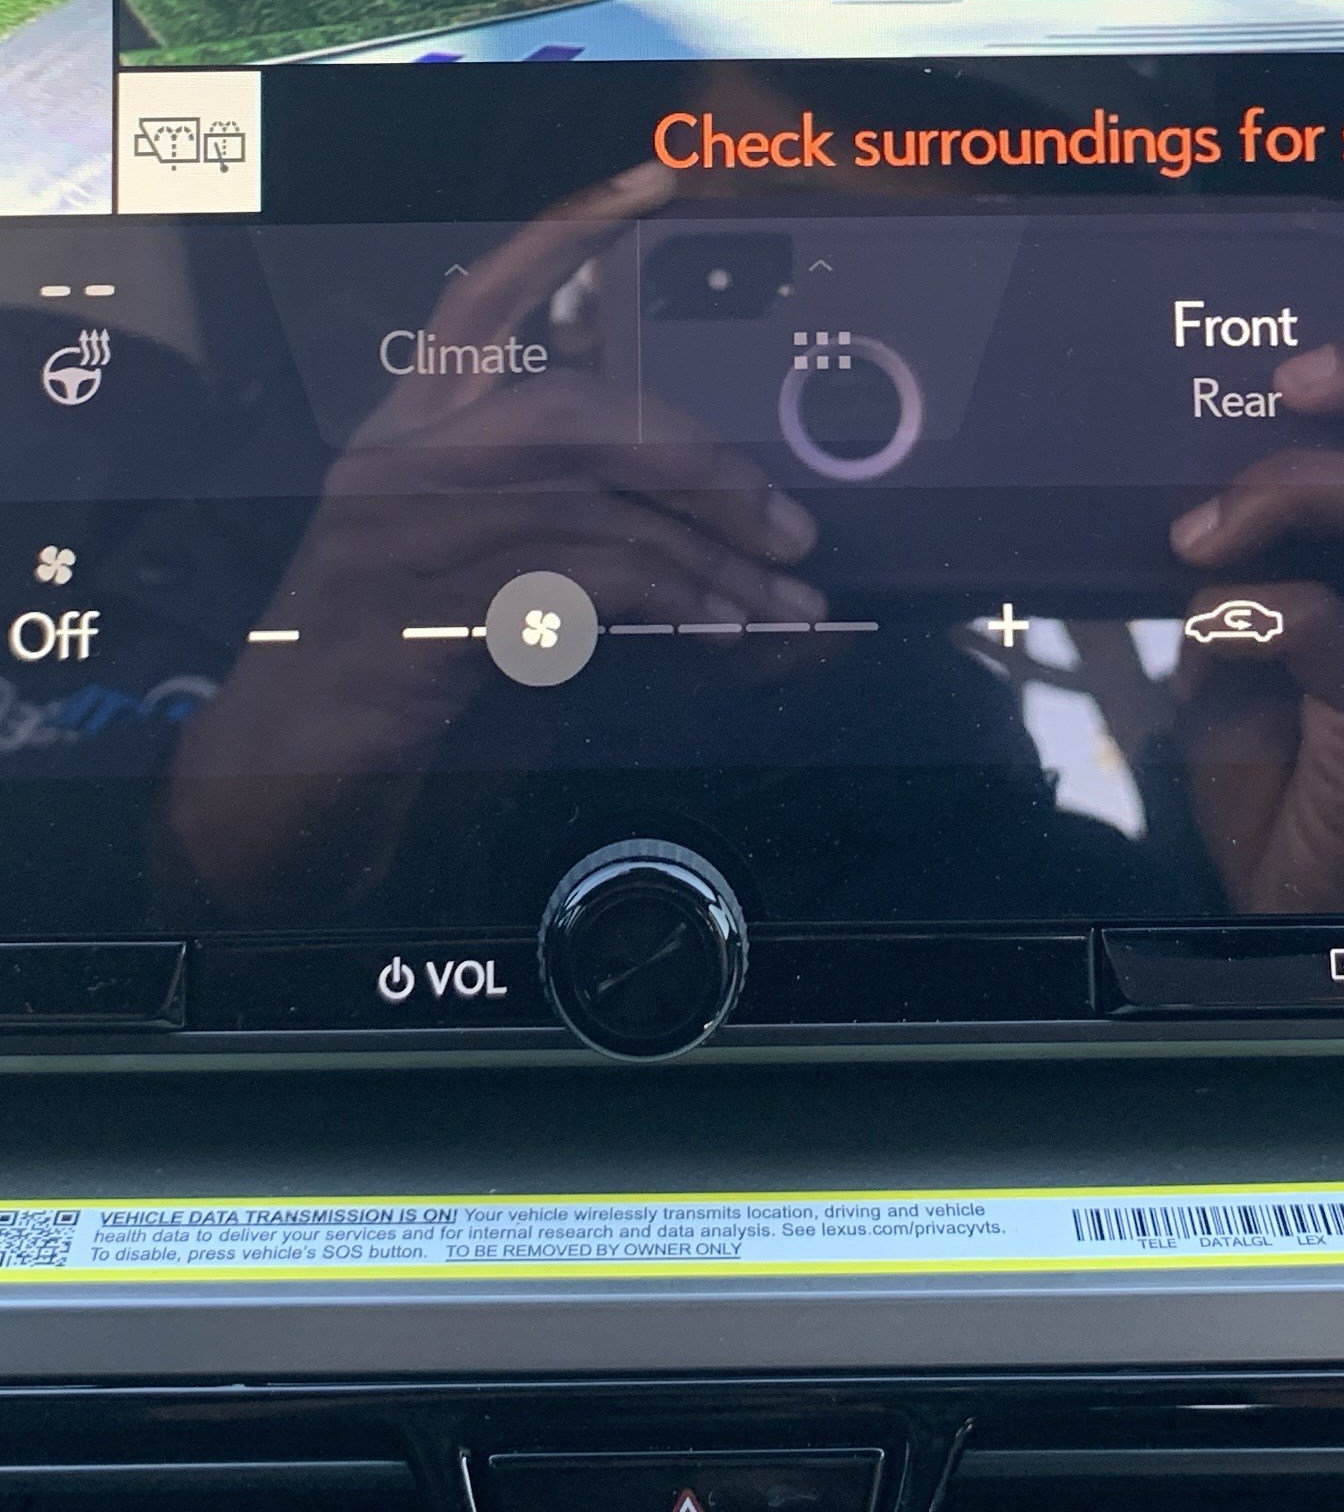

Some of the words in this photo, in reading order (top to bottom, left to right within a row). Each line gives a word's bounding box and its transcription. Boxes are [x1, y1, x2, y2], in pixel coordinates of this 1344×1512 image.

[652, 110, 835, 170] Check
[853, 108, 1222, 179] surroundings
[1237, 105, 1324, 163] for
[1173, 299, 1299, 348] Front
[379, 329, 548, 376] Climate
[1192, 376, 1283, 419] Rear
[9, 609, 102, 661] Off
[426, 959, 508, 997] VOL
[94, 1228, 147, 1243] health
[152, 1228, 190, 1243] data
[196, 1229, 212, 1242] to
[218, 1228, 277, 1242] deliver
[281, 1230, 321, 1244] your
[325, 1226, 396, 1241] services
[402, 1226, 434, 1240] and
[440, 1226, 463, 1240] for
[468, 1225, 532, 1239] internal
[538, 1225, 615, 1239] research
[619, 1225, 651, 1238] and
[657, 1224, 695, 1238] data
[700, 1223, 776, 1240] analysis.
[782, 1223, 816, 1237] See
[821, 1221, 1006, 1238] lexus.com/privacyvts.
[100, 1211, 184, 1225] VEHICLE
[188, 1211, 239, 1225] DATA
[245, 1208, 394, 1225] TRANSMISSION
[399, 1209, 418, 1223] IS
[423, 1208, 457, 1223] ON!
[464, 1208, 503, 1222] Your
[508, 1207, 568, 1221] vehicle
[574, 1205, 658, 1223] wirelessly
[663, 1205, 742, 1220] transmits
[747, 1204, 819, 1221] location,
[824, 1204, 881, 1221] driving
[887, 1203, 919, 1218] and
[925, 1203, 986, 1217] vehicle
[91, 1247, 110, 1262] To
[114, 1246, 181, 1263] disable,
[187, 1248, 236, 1264] press
[242, 1244, 316, 1260] vehicle's
[322, 1244, 363, 1260] SOS
[369, 1244, 428, 1259] button.
[446, 1245, 470, 1258] TO
[474, 1245, 498, 1257] BE
[502, 1244, 592, 1257] REMOVED
[597, 1244, 620, 1256] BY
[624, 1242, 691, 1256] OWNER
[696, 1242, 743, 1256] ONLY
[1137, 1237, 1178, 1249] TELE
[1297, 1235, 1328, 1246] LEX
